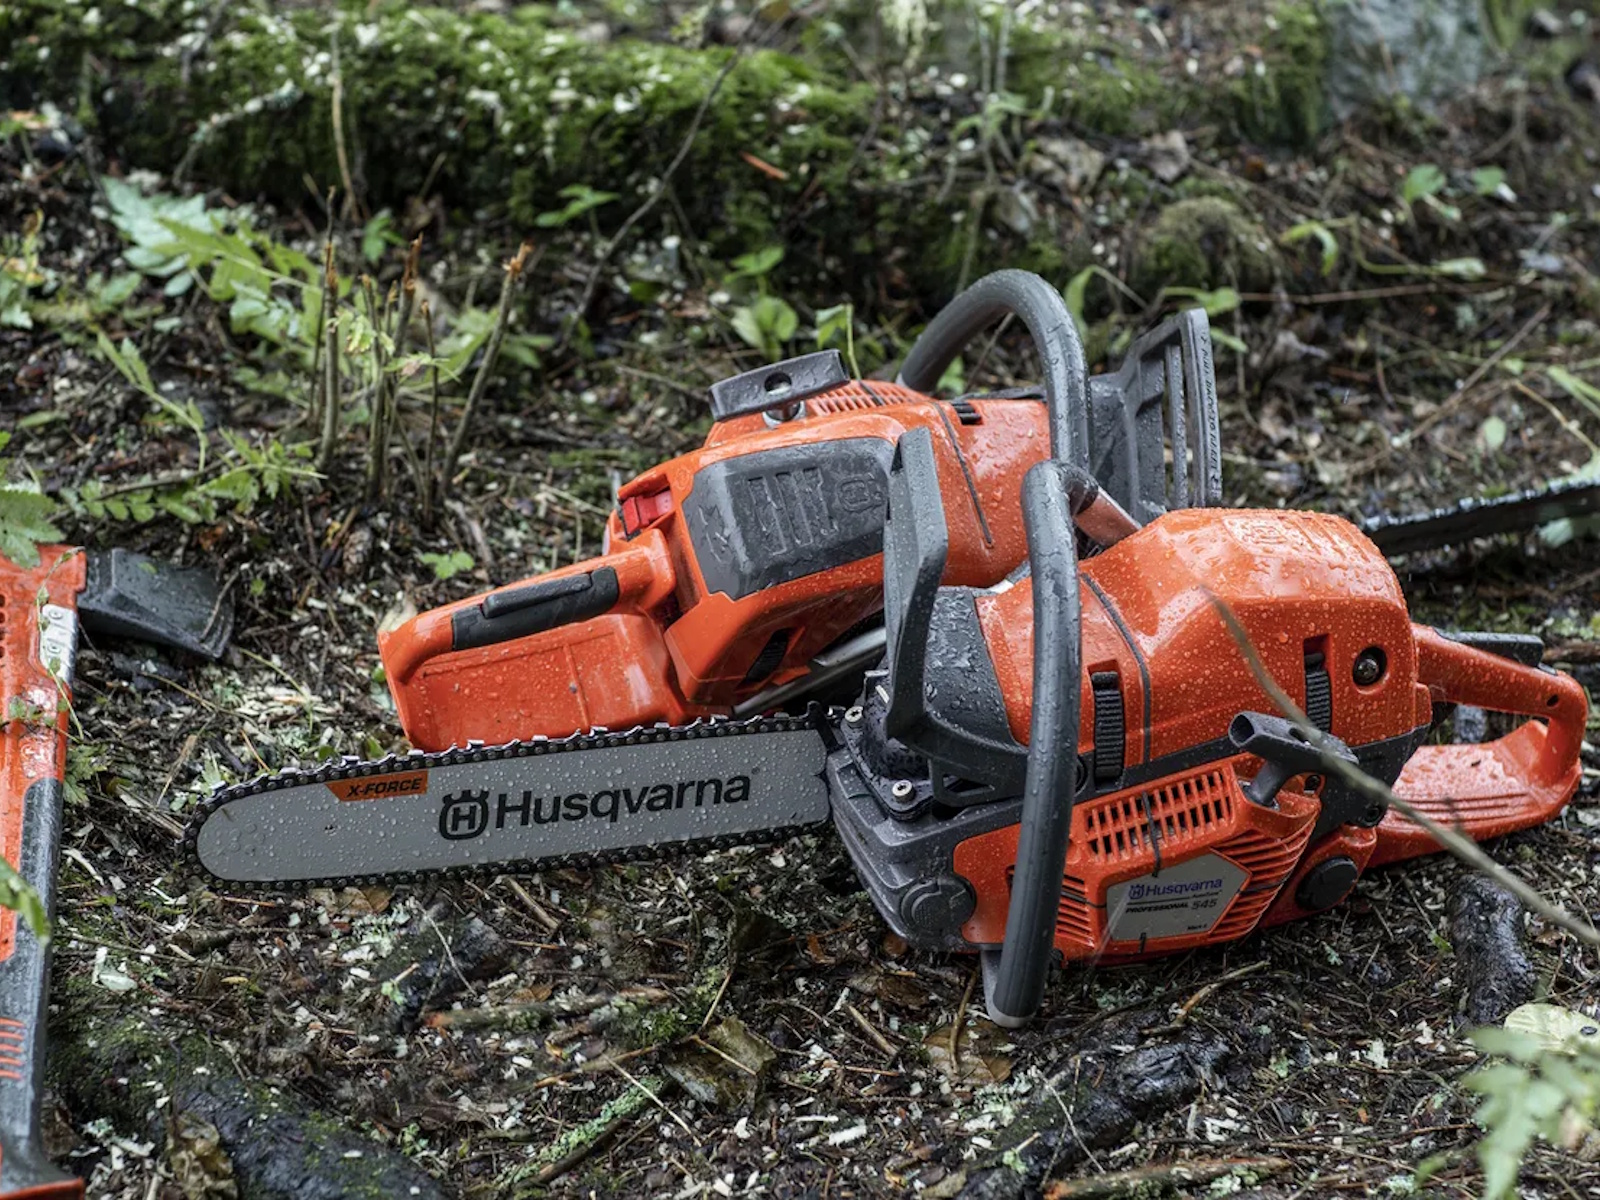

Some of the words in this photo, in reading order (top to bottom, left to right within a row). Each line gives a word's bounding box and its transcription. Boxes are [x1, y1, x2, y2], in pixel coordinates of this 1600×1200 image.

[346, 778, 422, 797] X-FORCE
[495, 774, 752, 828] Husqvarna
[1146, 879, 1222, 896] Husqvarna
[1125, 902, 1189, 913] PROFESSIONAL
[1191, 899, 1219, 910] 545
